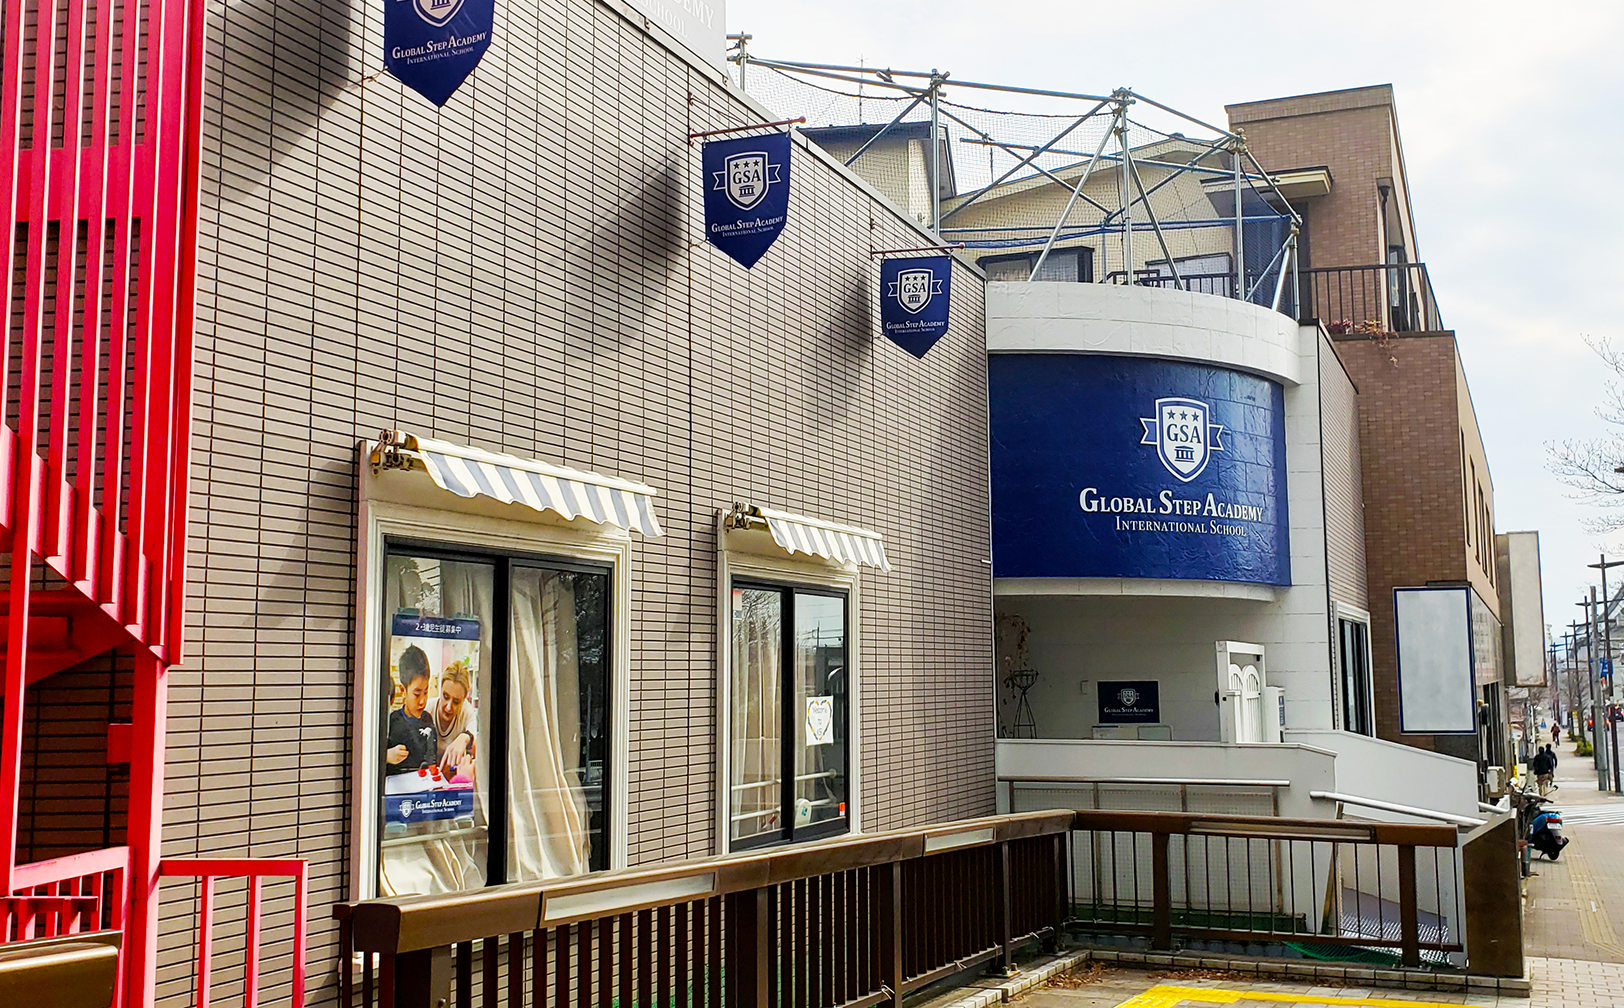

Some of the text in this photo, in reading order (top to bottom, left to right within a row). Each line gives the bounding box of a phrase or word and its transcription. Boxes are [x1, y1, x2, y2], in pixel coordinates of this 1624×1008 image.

[392, 31, 488, 59] GLOBAL STEP ACADEMY
[732, 169, 762, 184] GSA
[736, 219, 755, 230] STEP
[903, 282, 927, 293] GSA
[1166, 423, 1202, 444] GSA
[1079, 487, 1263, 522] GLOBAL STEP ACADEMY
[1115, 515, 1247, 537] INTERNATIONAL SCHOOL
